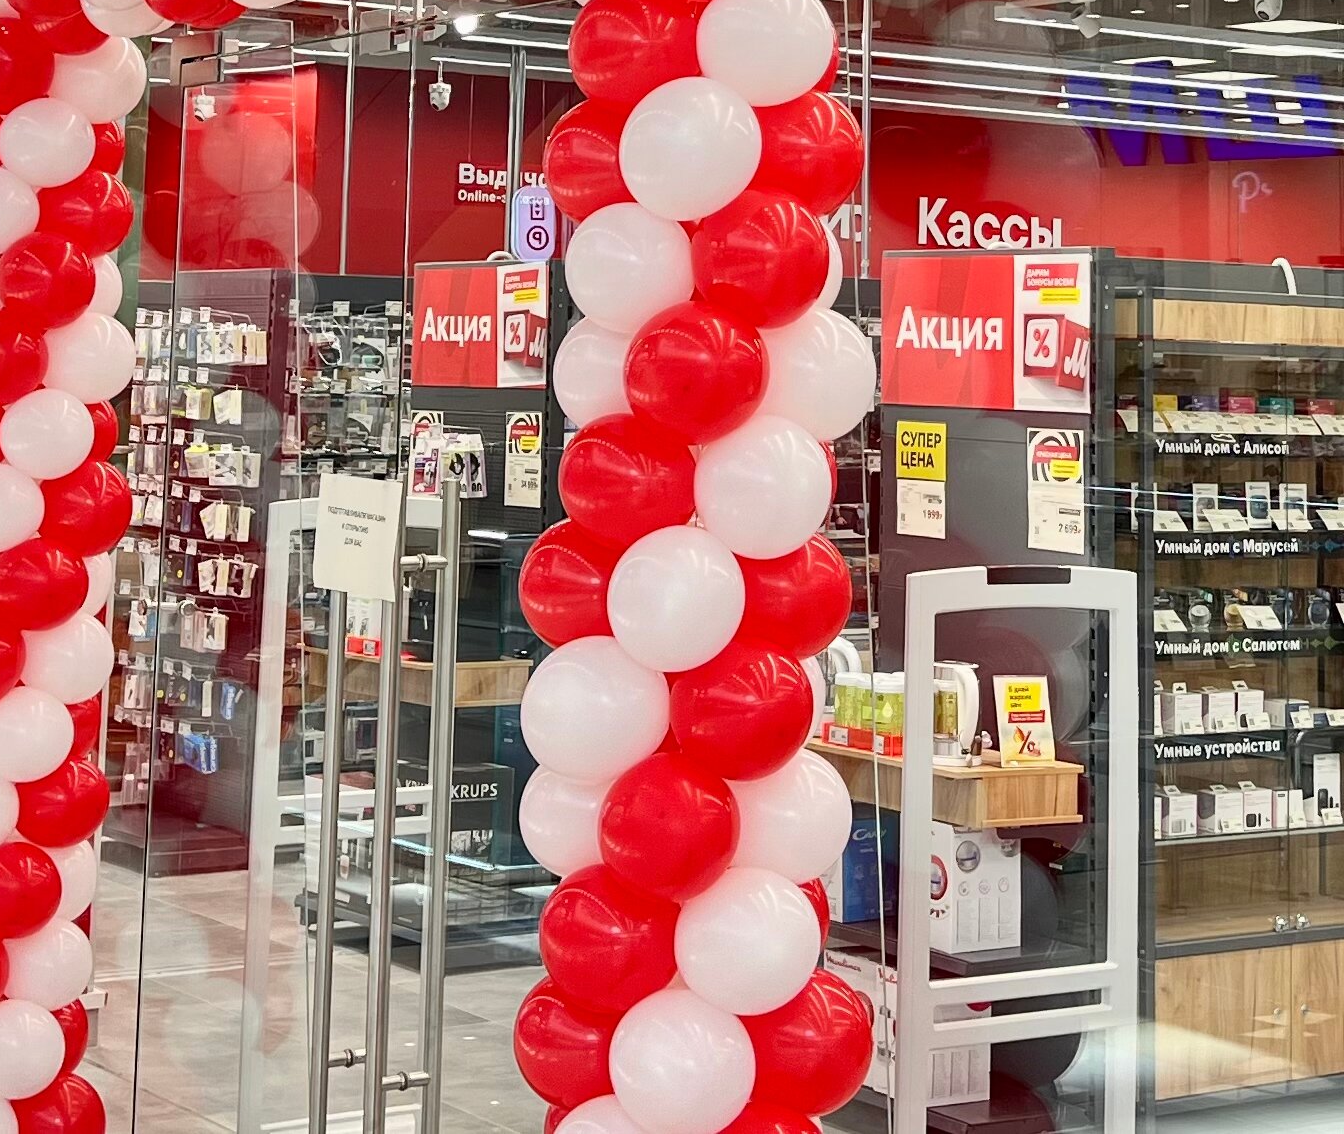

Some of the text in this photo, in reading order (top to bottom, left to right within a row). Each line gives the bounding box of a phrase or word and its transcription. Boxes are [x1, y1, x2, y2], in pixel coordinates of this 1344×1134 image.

[458, 163, 547, 189] Выдча
[918, 197, 1062, 249] Кассы
[421, 307, 492, 347] Акция
[896, 306, 1002, 357] Акция
[901, 431, 941, 449] СУПЕР
[1156, 439, 1289, 456] Умный дом с Алисой
[901, 452, 934, 469] ЦЕНА
[1156, 538, 1299, 557] Умный дом с Марусей
[1155, 638, 1301, 656] Умный дом с Салютом
[1154, 738, 1281, 759] Умные устройства
[451, 783, 498, 798] KRUPS
